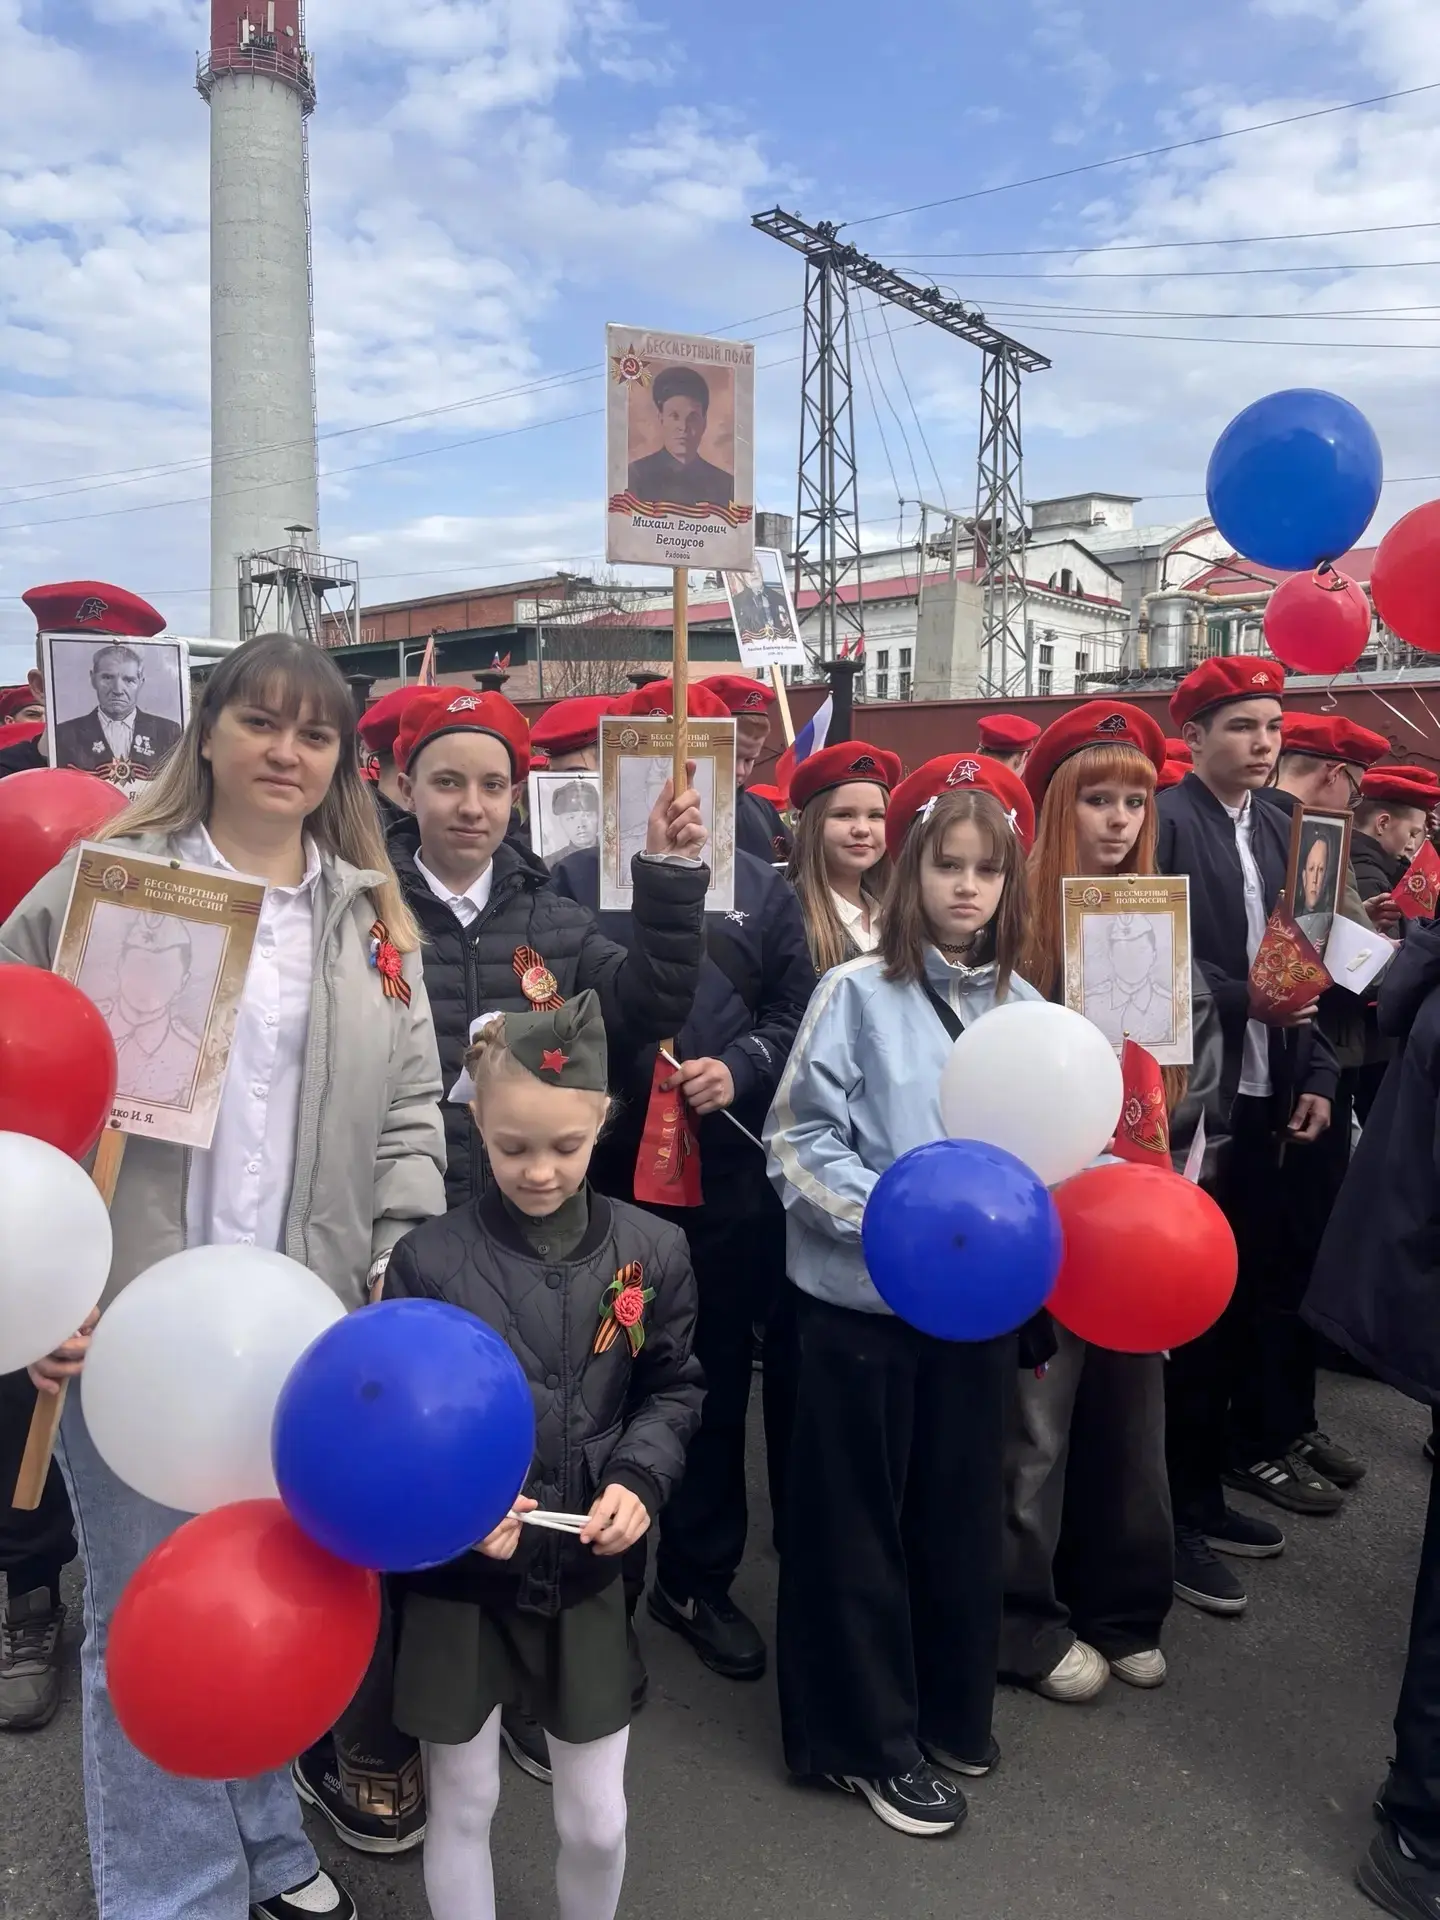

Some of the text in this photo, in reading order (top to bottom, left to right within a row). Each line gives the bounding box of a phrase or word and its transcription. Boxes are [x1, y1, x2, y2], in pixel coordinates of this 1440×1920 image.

[646, 337, 752, 365] БЕССМЕРТНЫЙ ПОЛК
[632, 516, 728, 535] Михаил Егорович
[656, 533, 704, 549] Белоусов
[665, 550, 690, 560] Рядовой
[650, 733, 710, 741] БЕССТНЫЙ
[143, 877, 229, 903] БЕССМЕРТНЫЙ
[1114, 889, 1169, 897] БЕССМЕРТНЫЙ
[145, 888, 224, 912] ПОЛК РОССИИ
[110, 1108, 129, 1118] нко
[144, 1113, 154, 1124] Я.
